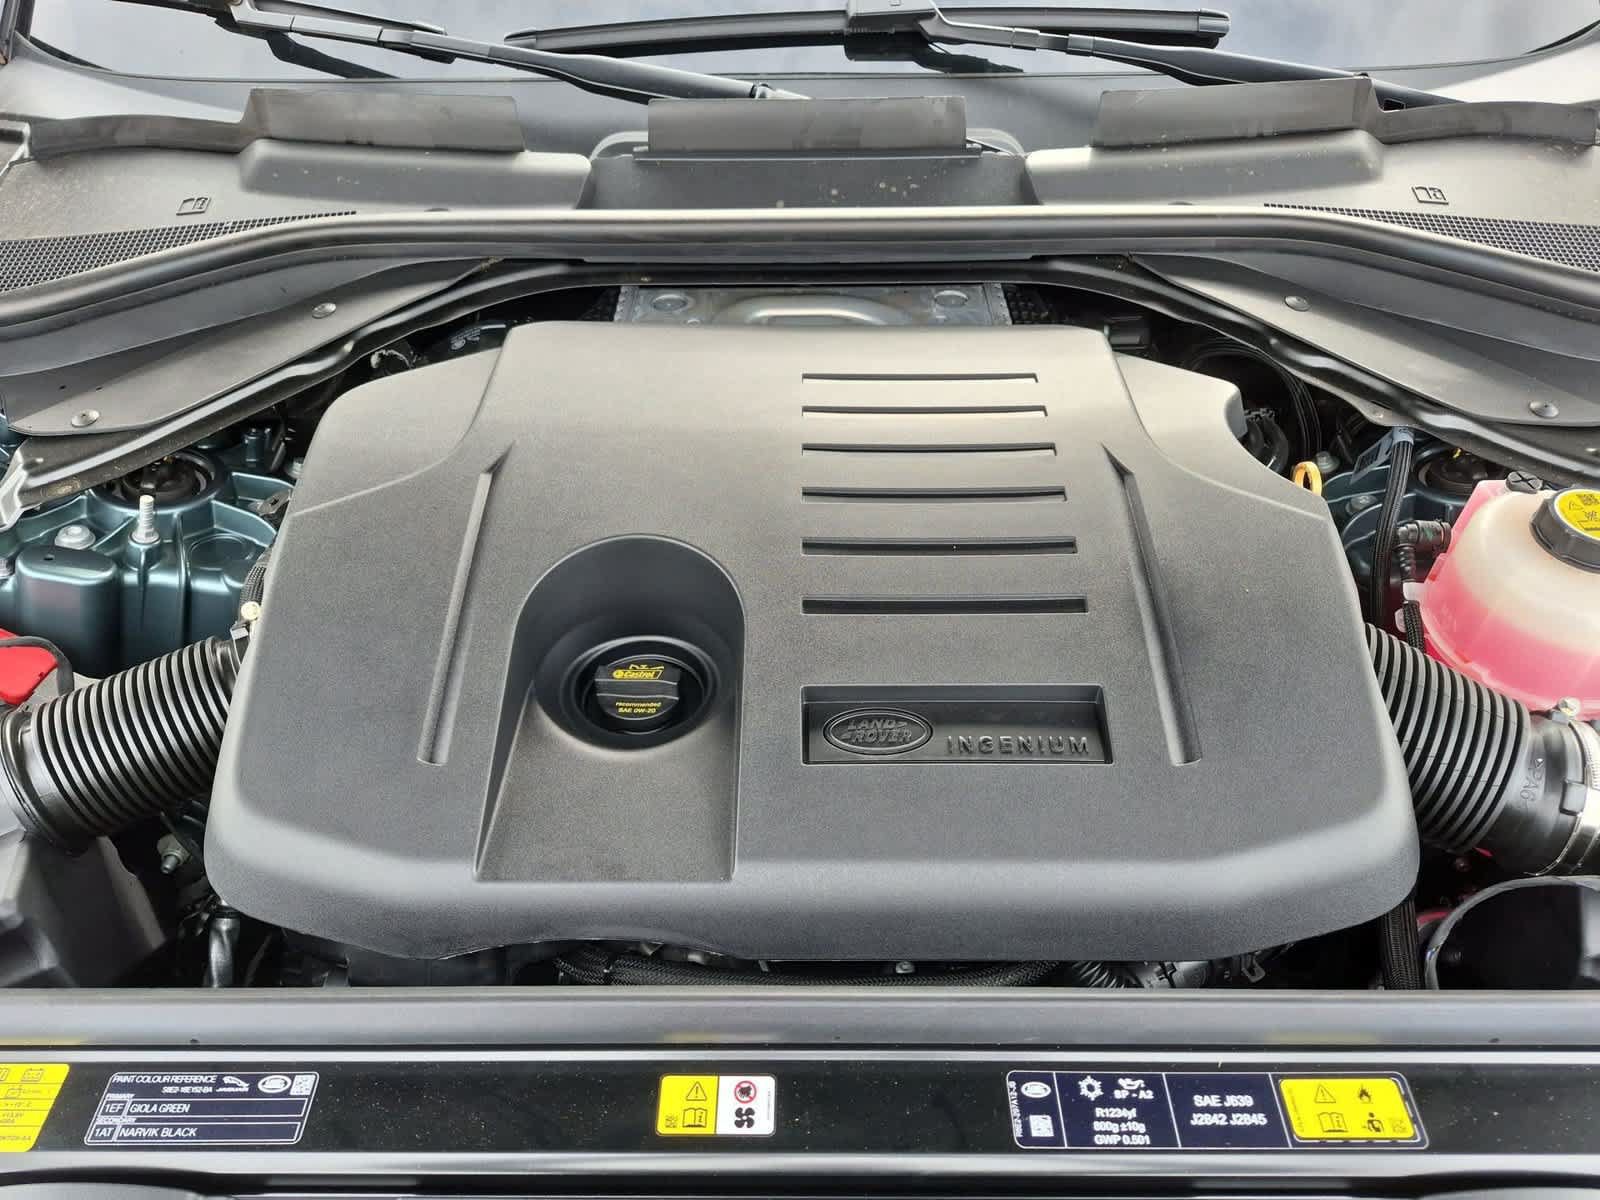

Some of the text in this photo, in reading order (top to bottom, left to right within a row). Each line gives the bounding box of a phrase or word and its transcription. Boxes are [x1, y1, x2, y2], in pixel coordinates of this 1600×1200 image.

[623, 670, 655, 678] Castrol
[851, 729, 913, 743] ROVER
[946, 735, 1090, 756] INGENIUM
[112, 1074, 218, 1083] PAINT COLOUR REFERENCE
[1193, 1095, 1254, 1107] SAE J639
[104, 1103, 191, 1113] 1EF GIOLA GREEN
[1095, 1107, 1137, 1120] R1234yf
[1190, 1113, 1268, 1126] J2842 J2845
[94, 1127, 198, 1137] 1AT NARVIK BLACK
[1094, 1134, 1151, 1145] GWP 0.501
